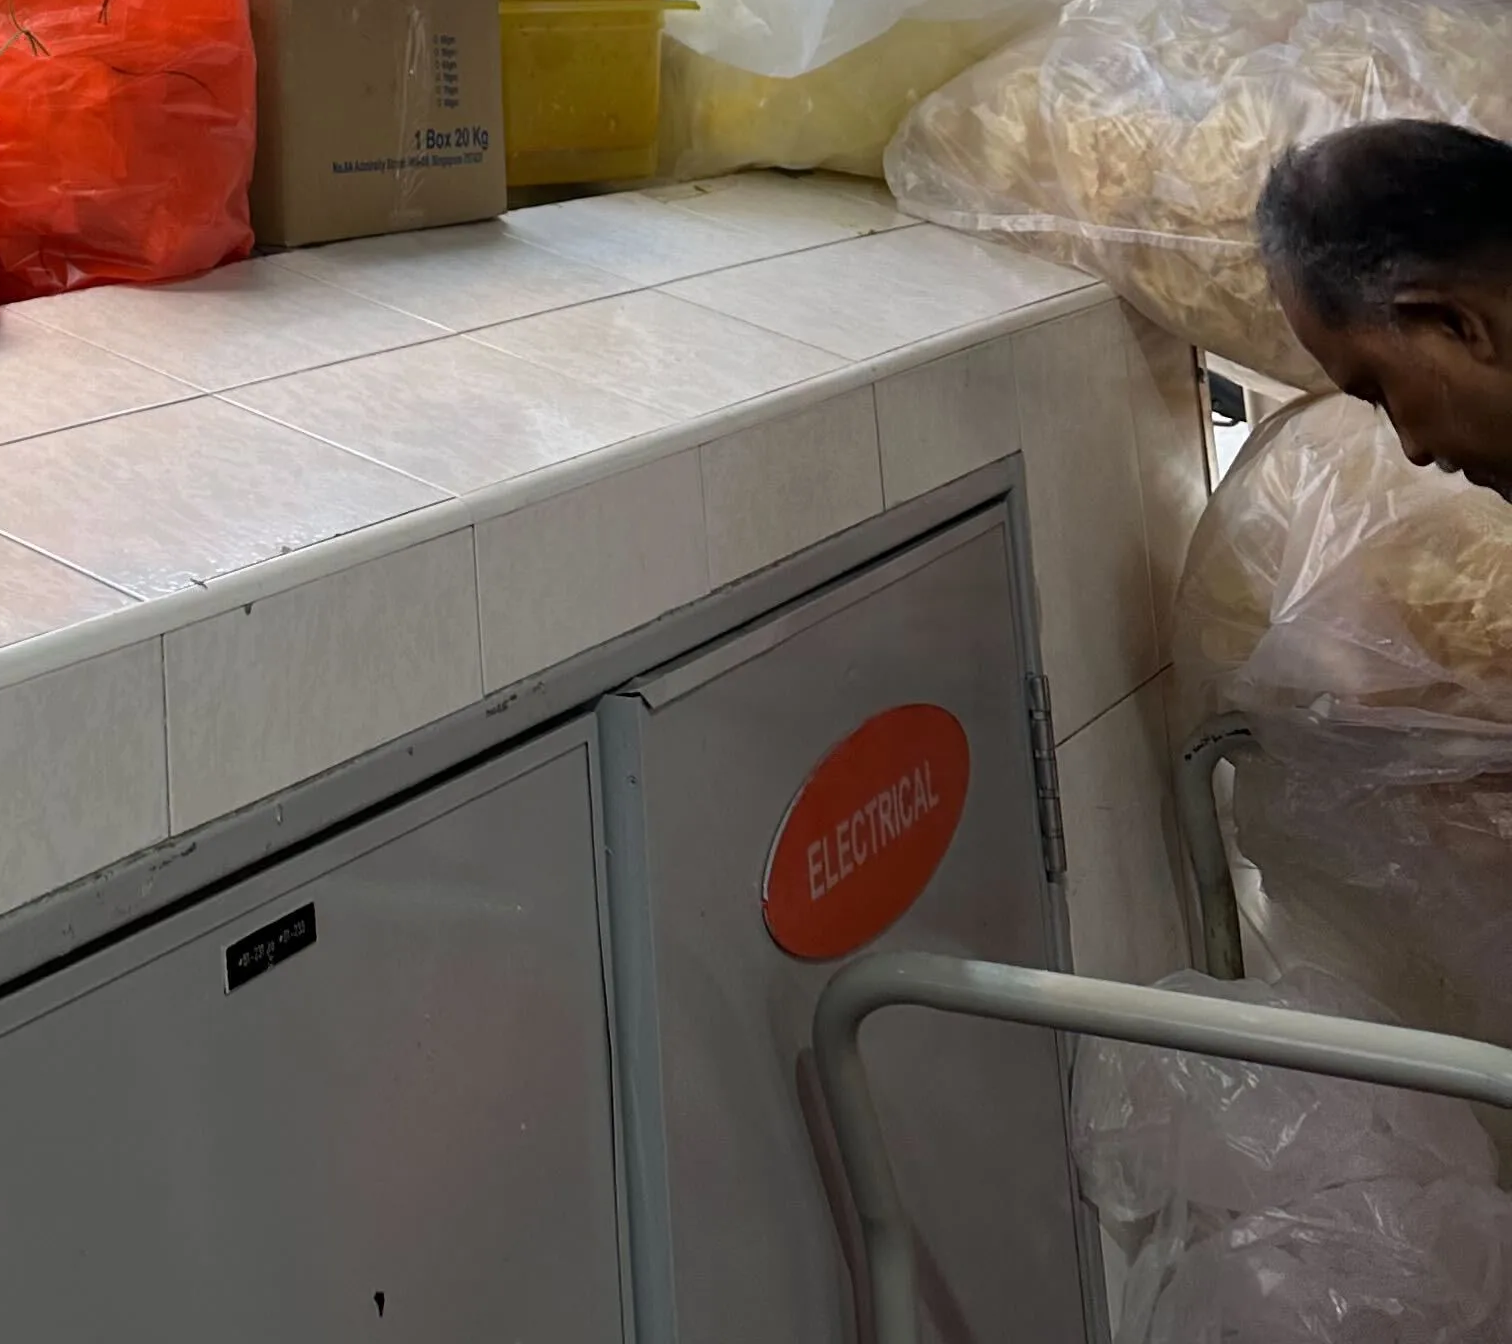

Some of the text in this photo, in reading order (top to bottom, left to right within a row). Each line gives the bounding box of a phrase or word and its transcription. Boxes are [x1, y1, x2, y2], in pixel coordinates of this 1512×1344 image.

[425, 128, 452, 150] Box
[454, 127, 470, 147] 20
[472, 126, 489, 151] Kg
[806, 759, 939, 902] ELECTRICAL
